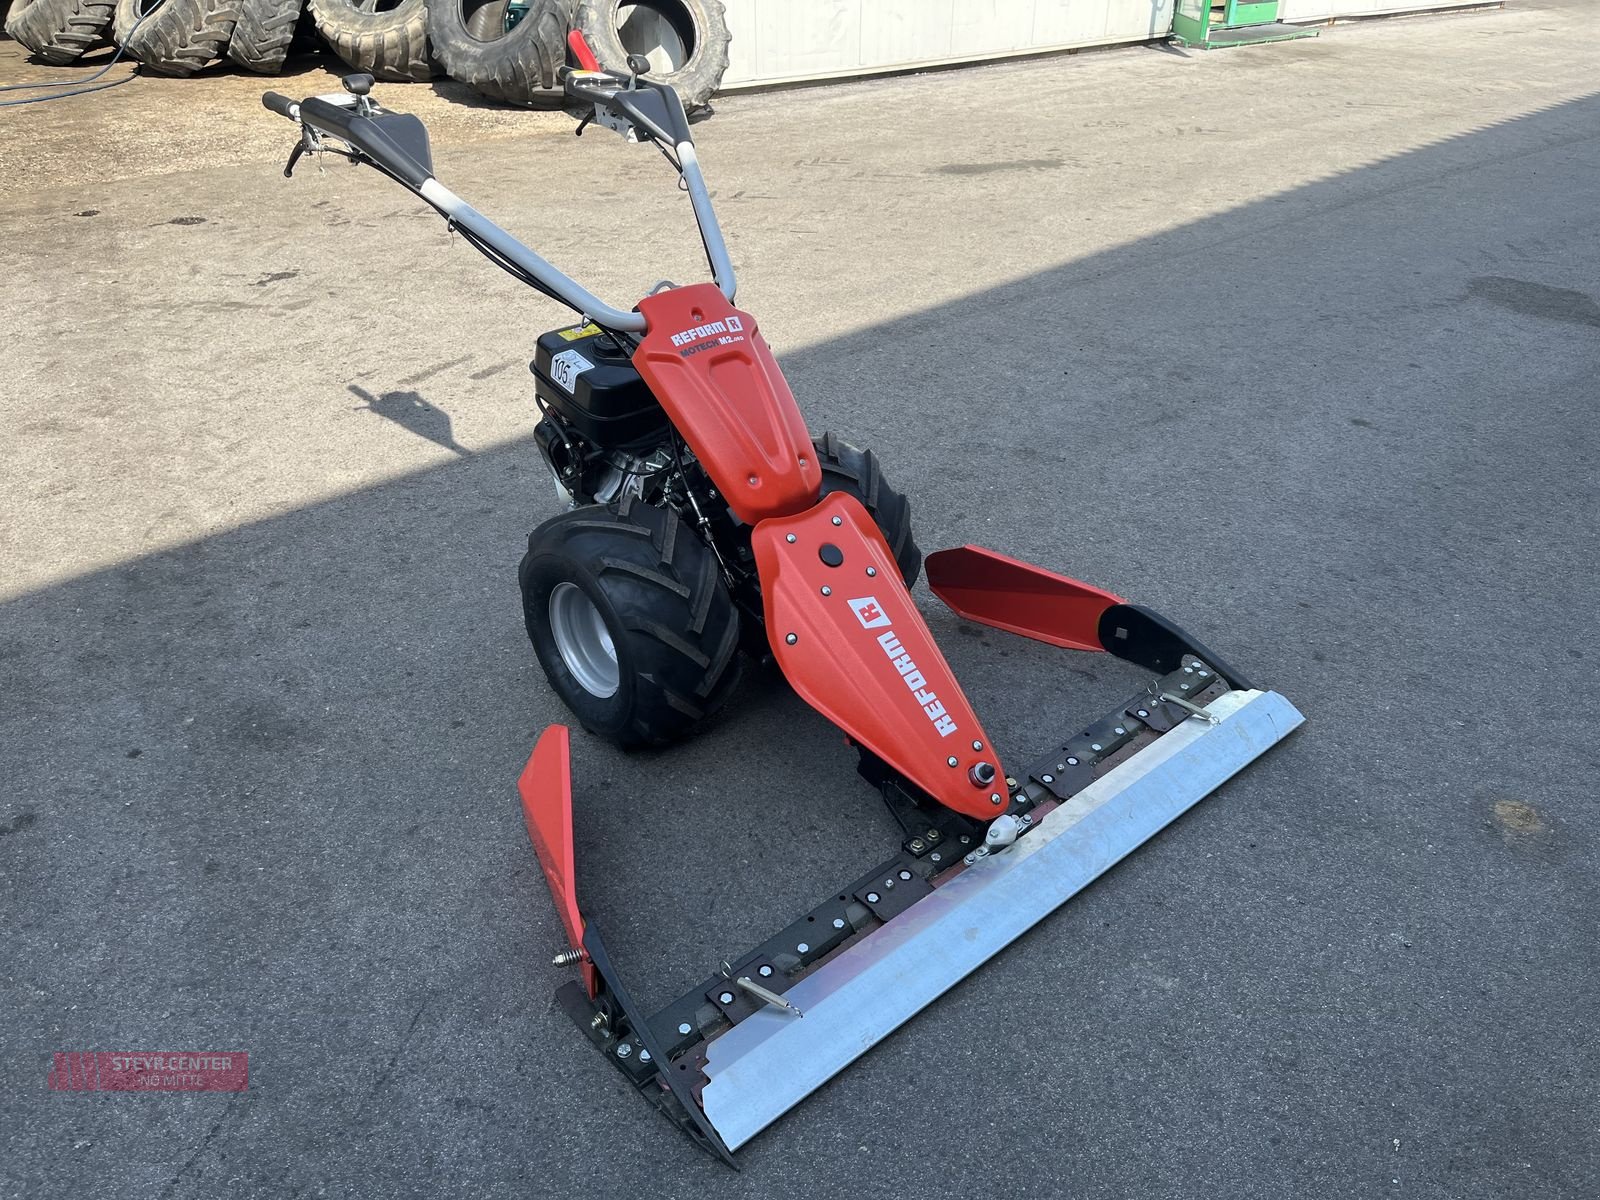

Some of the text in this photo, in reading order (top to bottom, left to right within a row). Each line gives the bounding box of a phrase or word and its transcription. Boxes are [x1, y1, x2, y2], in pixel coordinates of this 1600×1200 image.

[670, 321, 727, 346] REFORM
[680, 340, 720, 357] MOTECH
[554, 358, 571, 384] 105
[876, 631, 958, 738] REFORM
